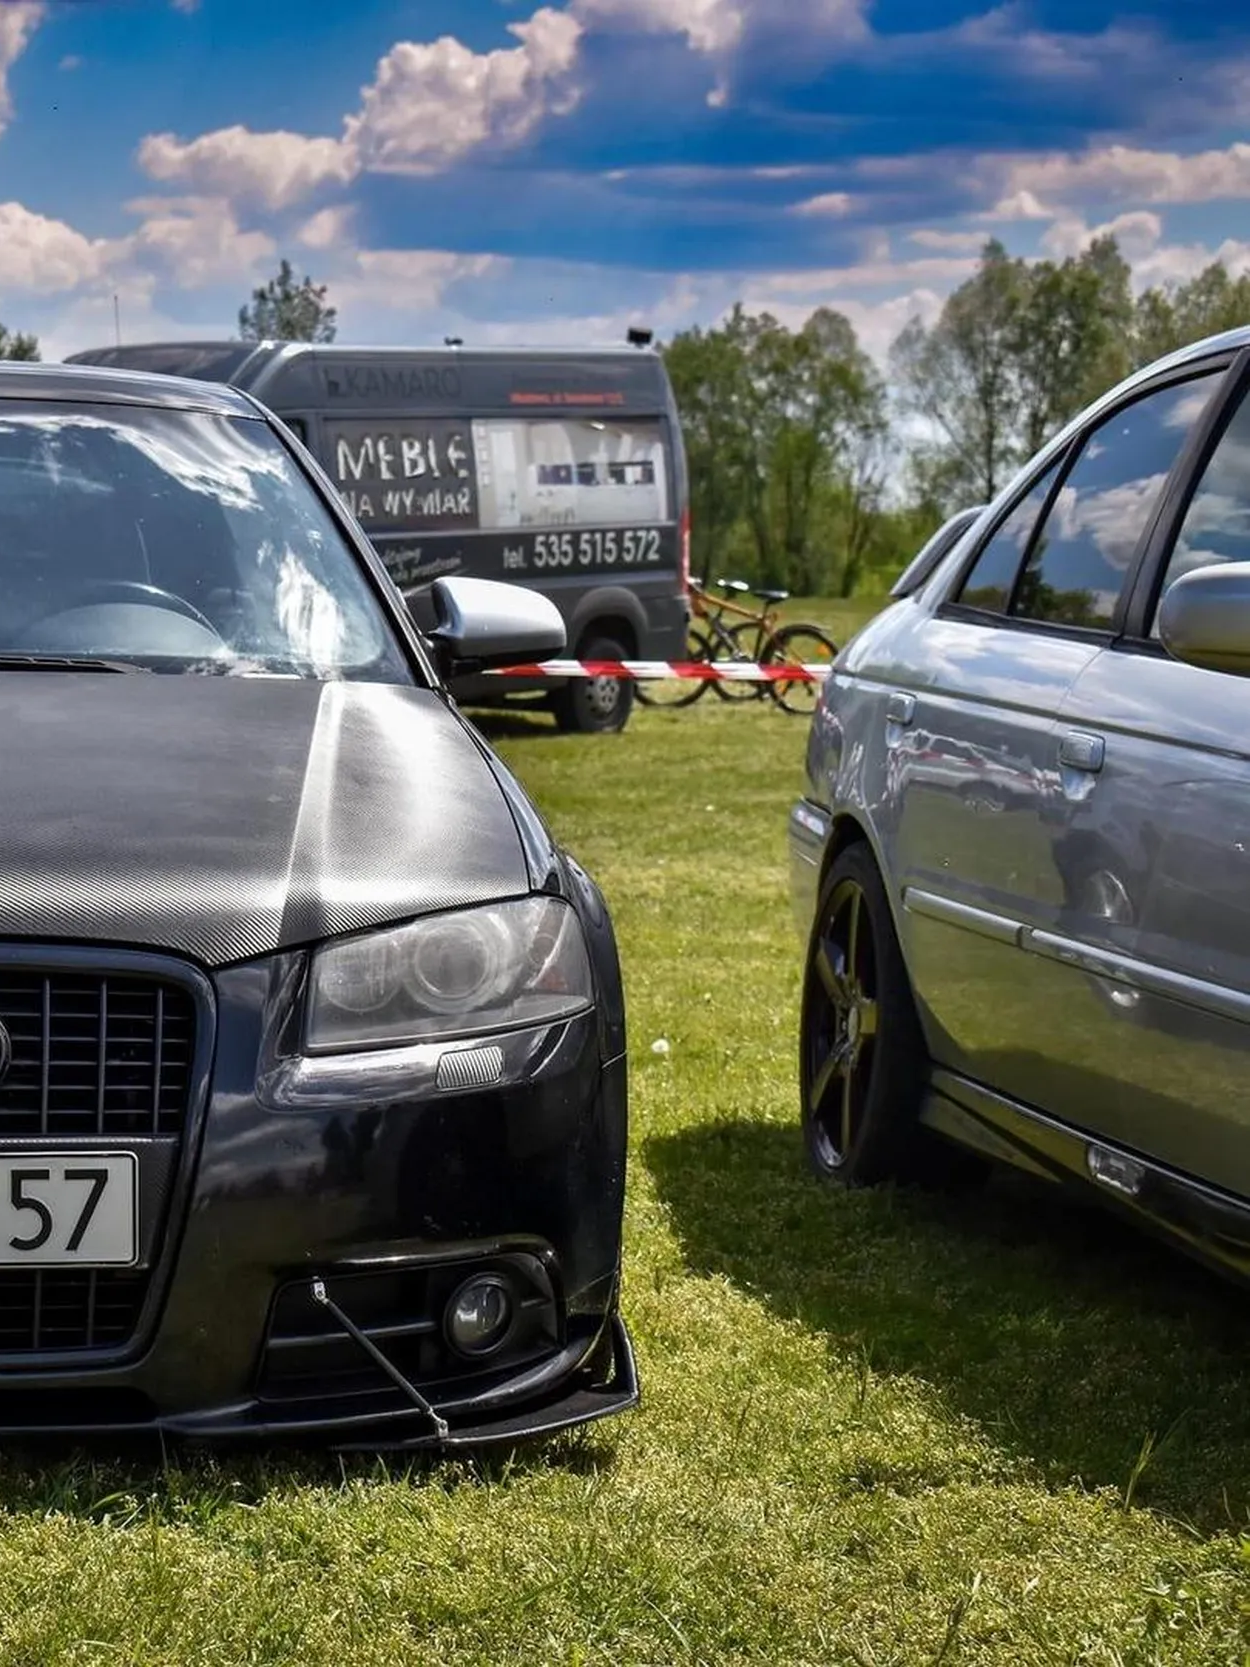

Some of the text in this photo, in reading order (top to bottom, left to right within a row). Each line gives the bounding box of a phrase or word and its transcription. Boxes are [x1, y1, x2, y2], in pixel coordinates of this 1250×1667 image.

[337, 435, 469, 480] MEBLE
[383, 487, 470, 515] WYMIAR
[534, 534, 573, 567] 535
[578, 531, 618, 565] 515
[622, 529, 661, 562] 572
